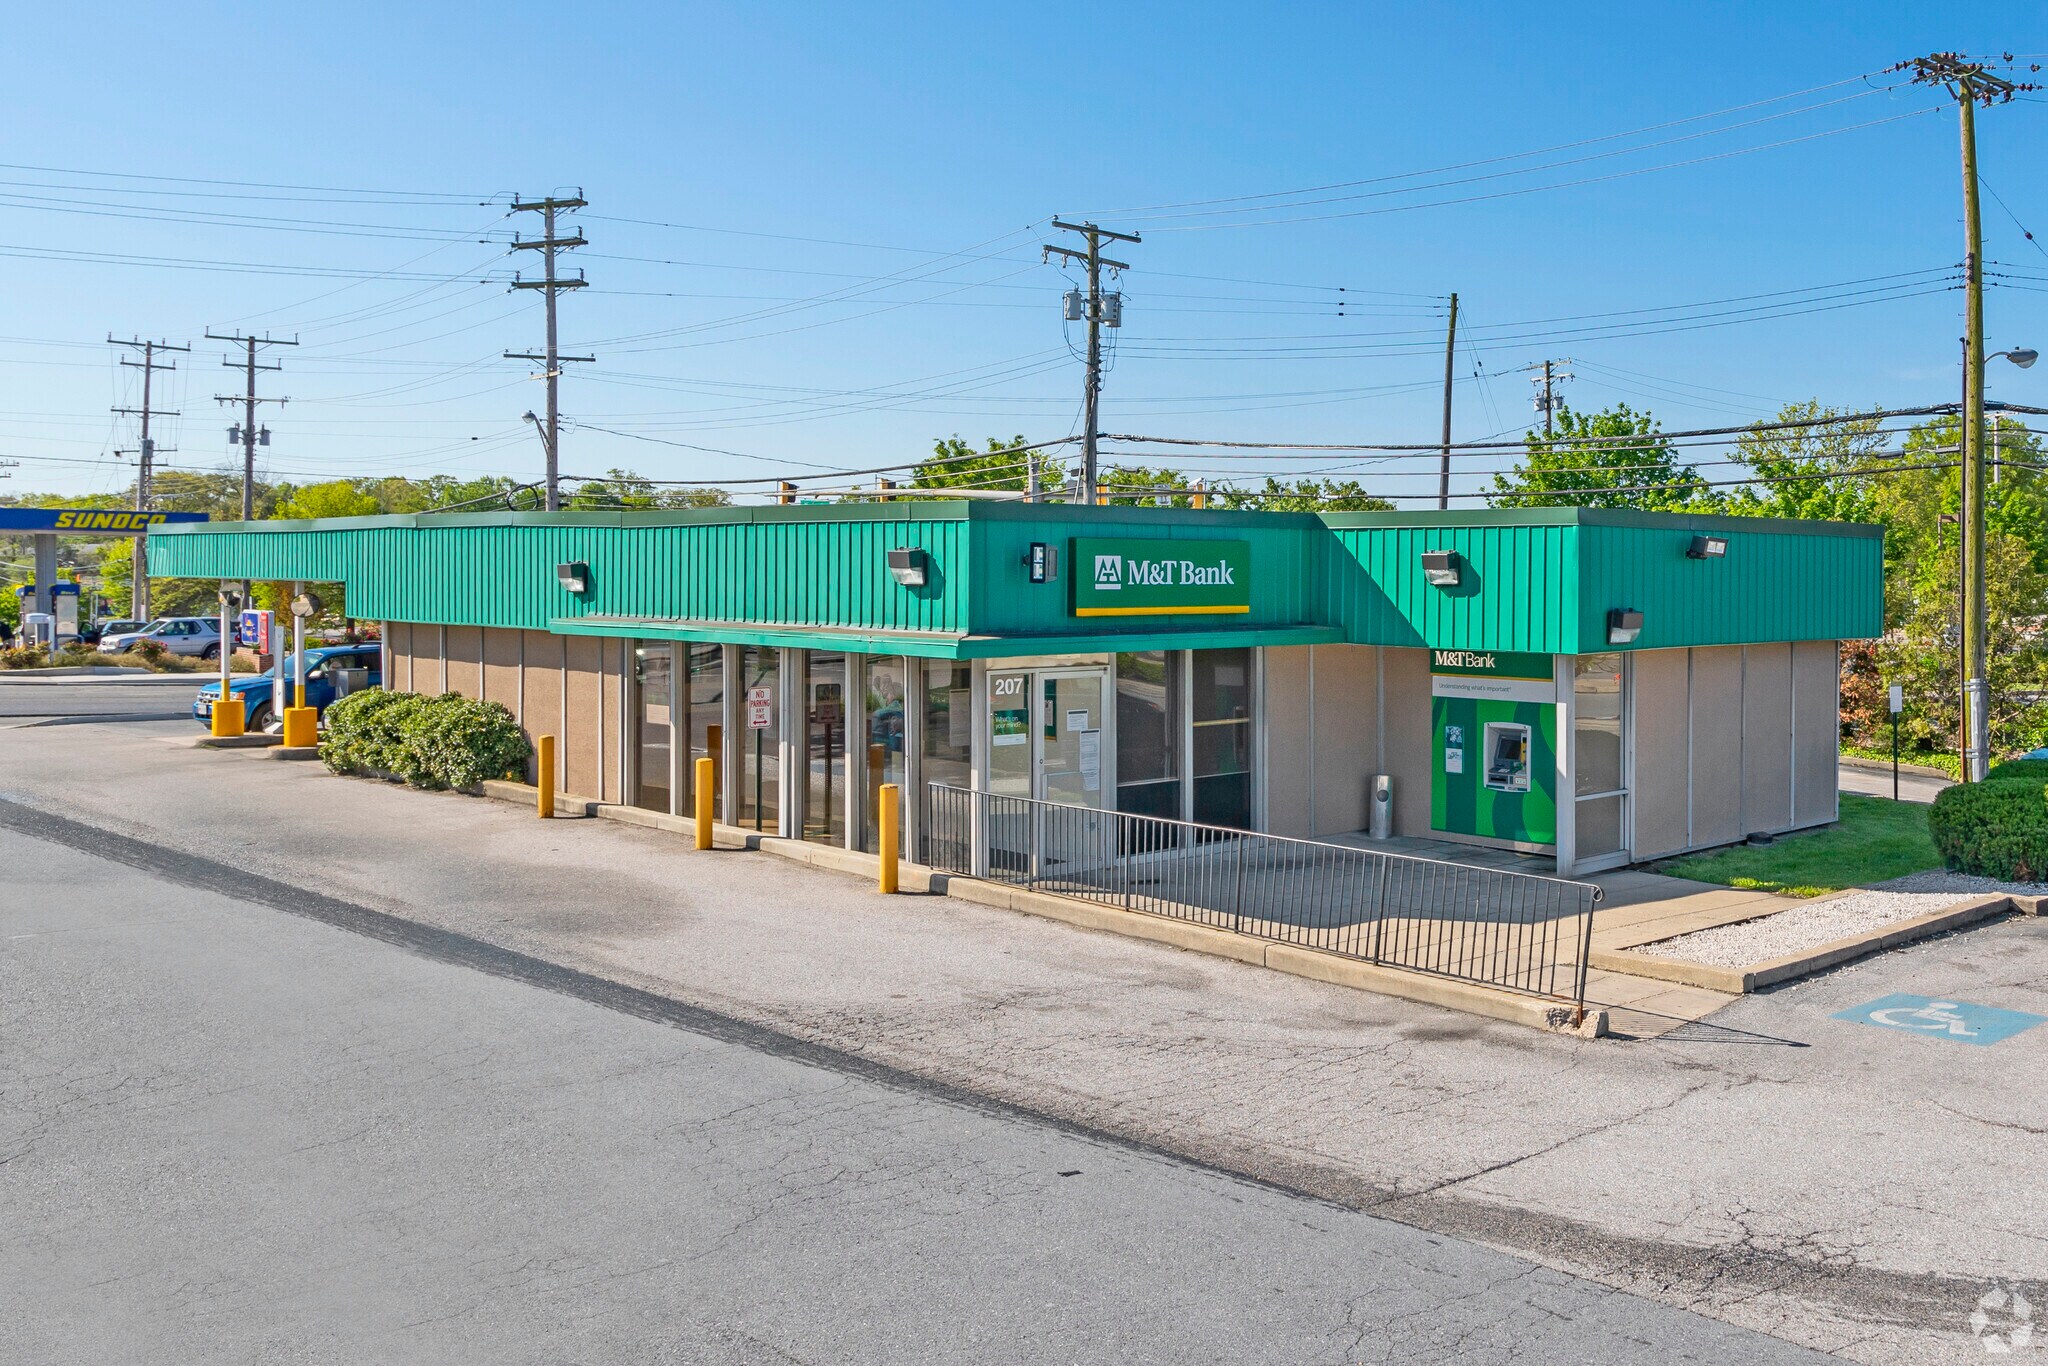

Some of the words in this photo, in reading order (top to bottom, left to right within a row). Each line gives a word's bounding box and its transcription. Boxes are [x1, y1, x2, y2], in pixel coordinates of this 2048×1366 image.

[1128, 560, 1178, 585] M&T
[1179, 560, 1235, 585] Bank
[1435, 650, 1465, 667] M&T
[1465, 652, 1495, 668] Bank
[995, 678, 1023, 695] 207
[1439, 683, 1470, 691] Understanding
[756, 690, 765, 699] NO
[750, 699, 770, 707] PARKING
